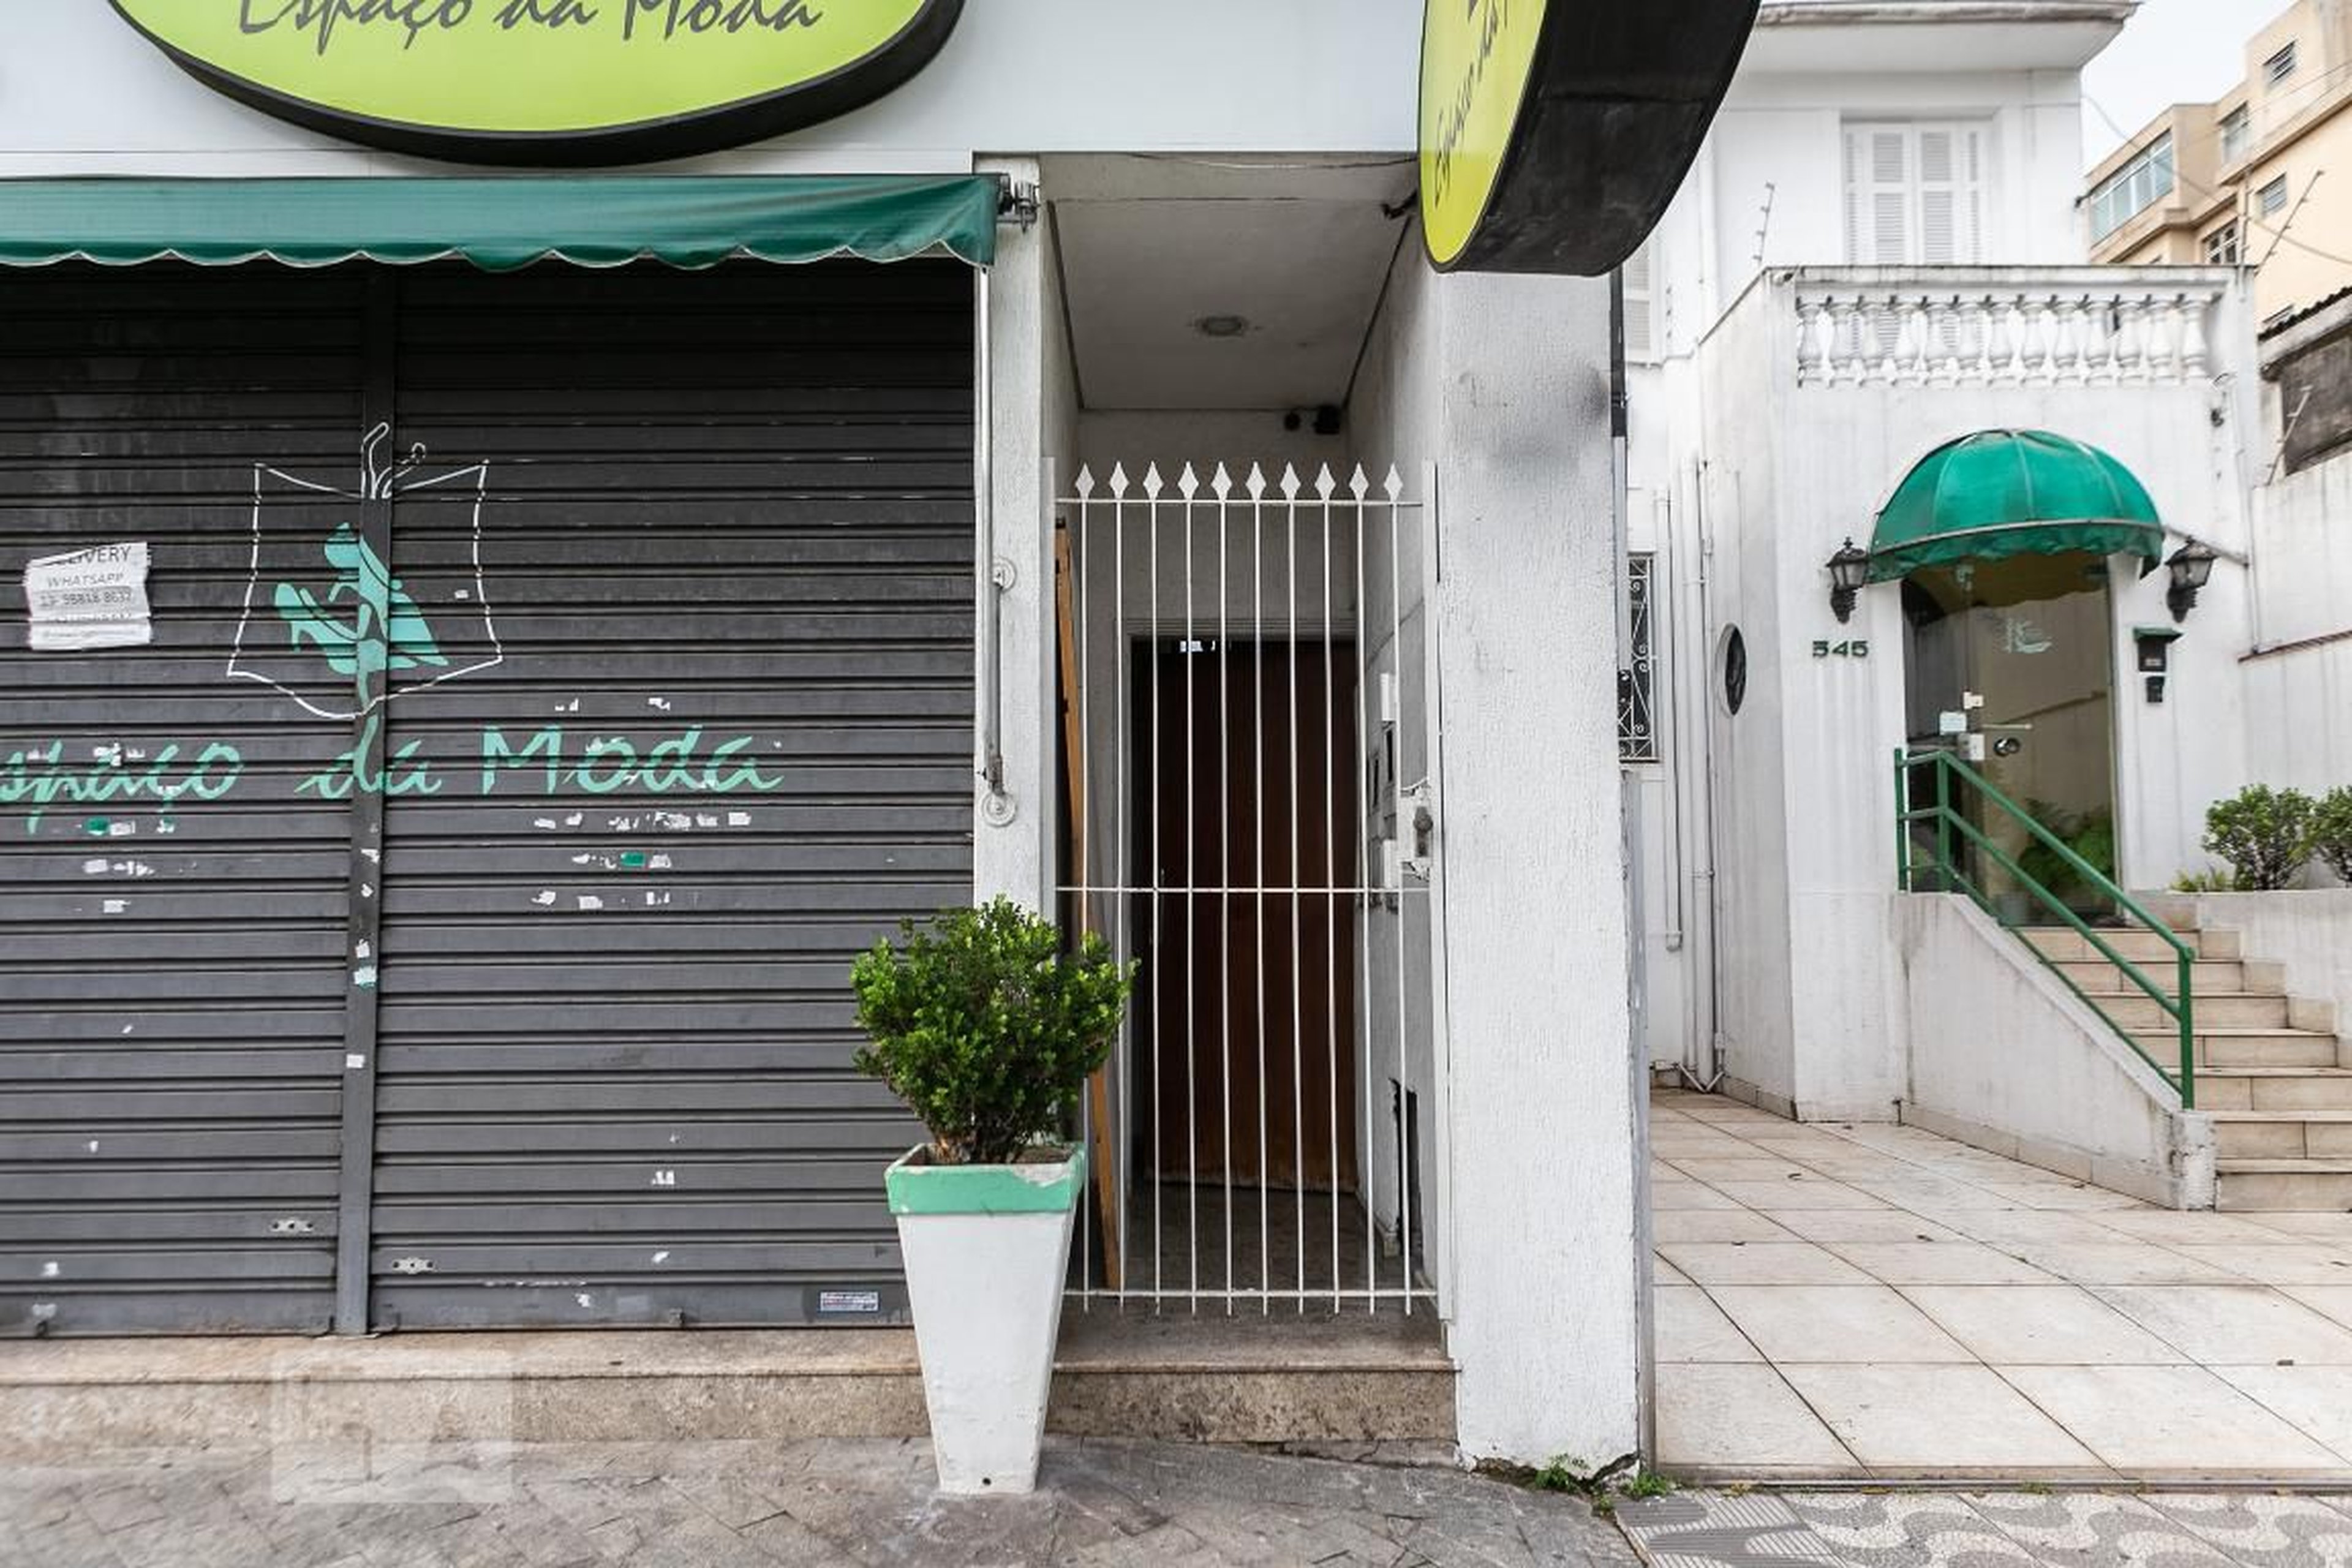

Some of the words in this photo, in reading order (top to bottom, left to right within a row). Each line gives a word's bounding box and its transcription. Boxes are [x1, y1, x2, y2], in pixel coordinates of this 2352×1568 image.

[1812, 641, 1868, 657] 545
[0, 734, 243, 834] spaço
[293, 714, 442, 799] da
[482, 724, 784, 795] Moda
